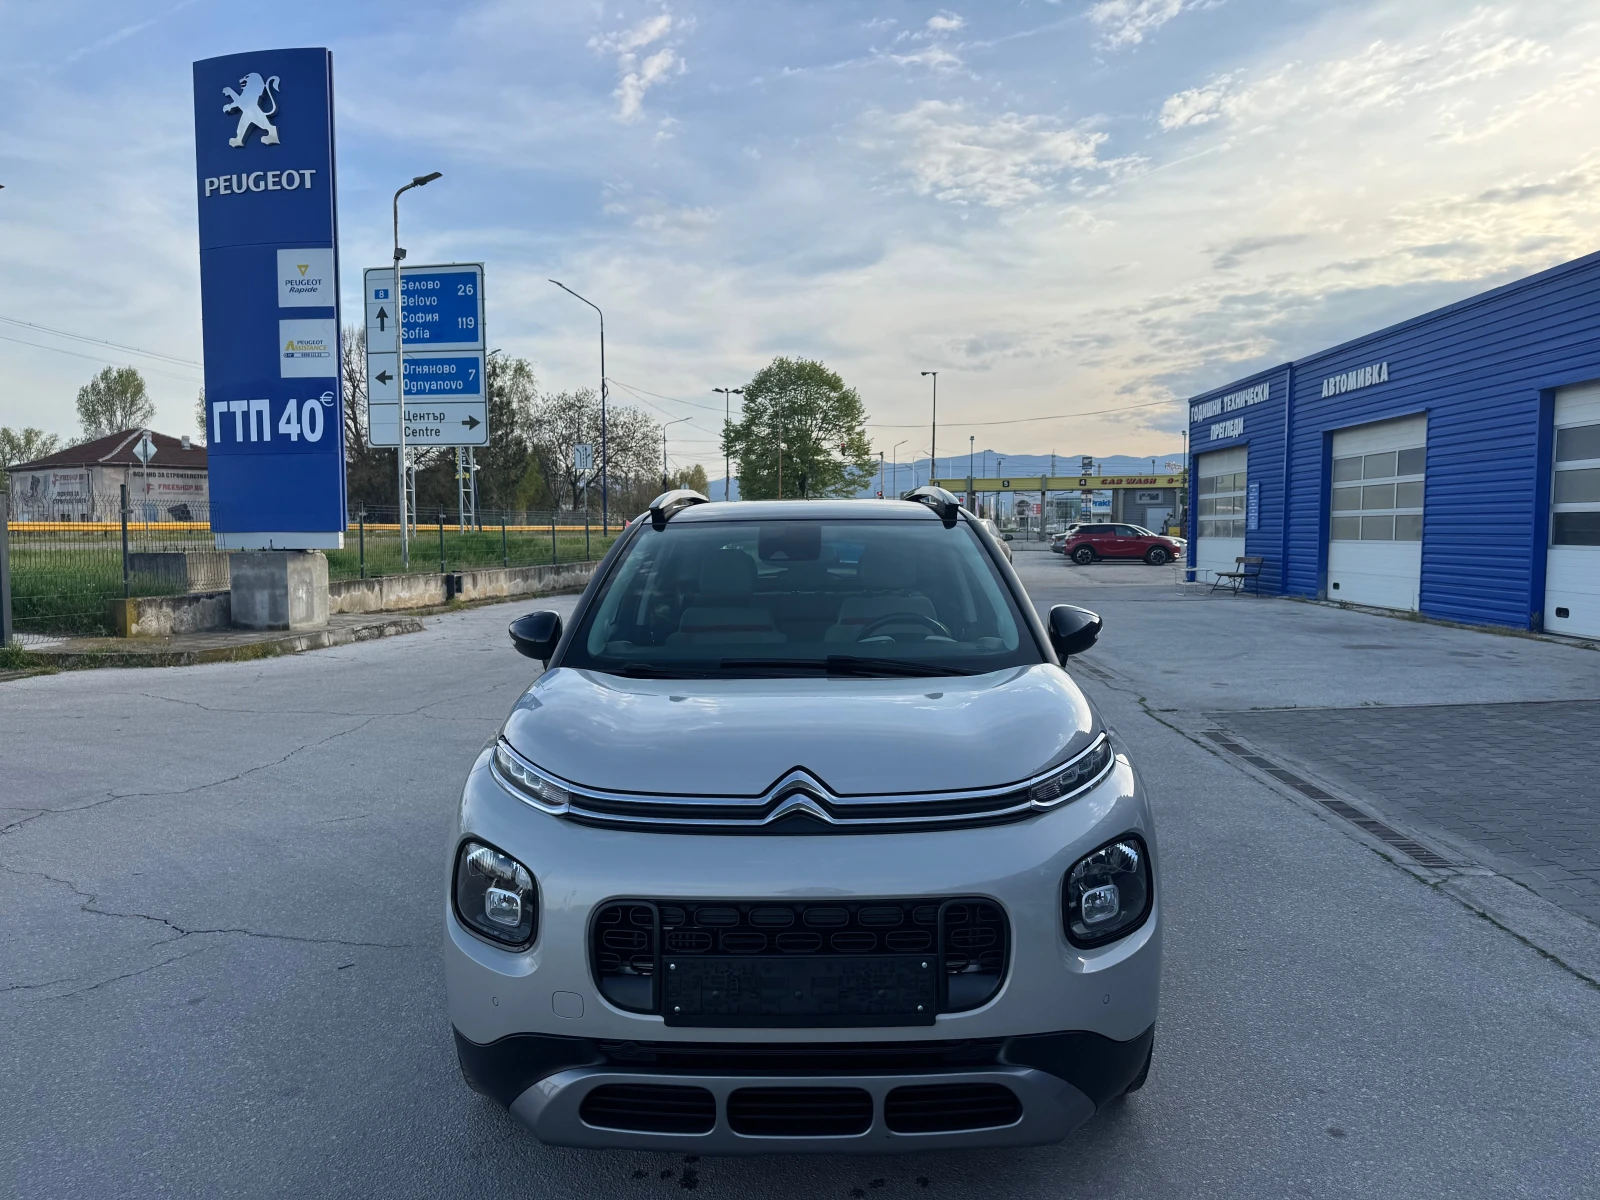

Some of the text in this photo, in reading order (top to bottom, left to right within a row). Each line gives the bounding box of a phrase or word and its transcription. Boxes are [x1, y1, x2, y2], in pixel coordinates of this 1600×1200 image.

[204, 169, 316, 197] PEUGEOT
[288, 286, 318, 294] Rapide
[400, 279, 440, 291] Белово
[457, 284, 474, 296] 26
[379, 290, 384, 298] 8
[401, 294, 438, 306] Belovo
[401, 311, 439, 324] София
[457, 317, 475, 329] 119
[401, 327, 430, 339] Sofia
[403, 363, 456, 374] Огняново
[468, 369, 476, 381] 7
[1321, 361, 1389, 398] АВТОМИВКА
[403, 379, 464, 393] Ognyanovo
[1190, 382, 1270, 423] ГОДИШНИ ТЕХНИЧЕСКИ
[212, 399, 271, 444] ГТП
[403, 410, 446, 424] Център
[404, 426, 441, 437] Centre
[1210, 417, 1244, 441] ПРЕГЛЕДИ
